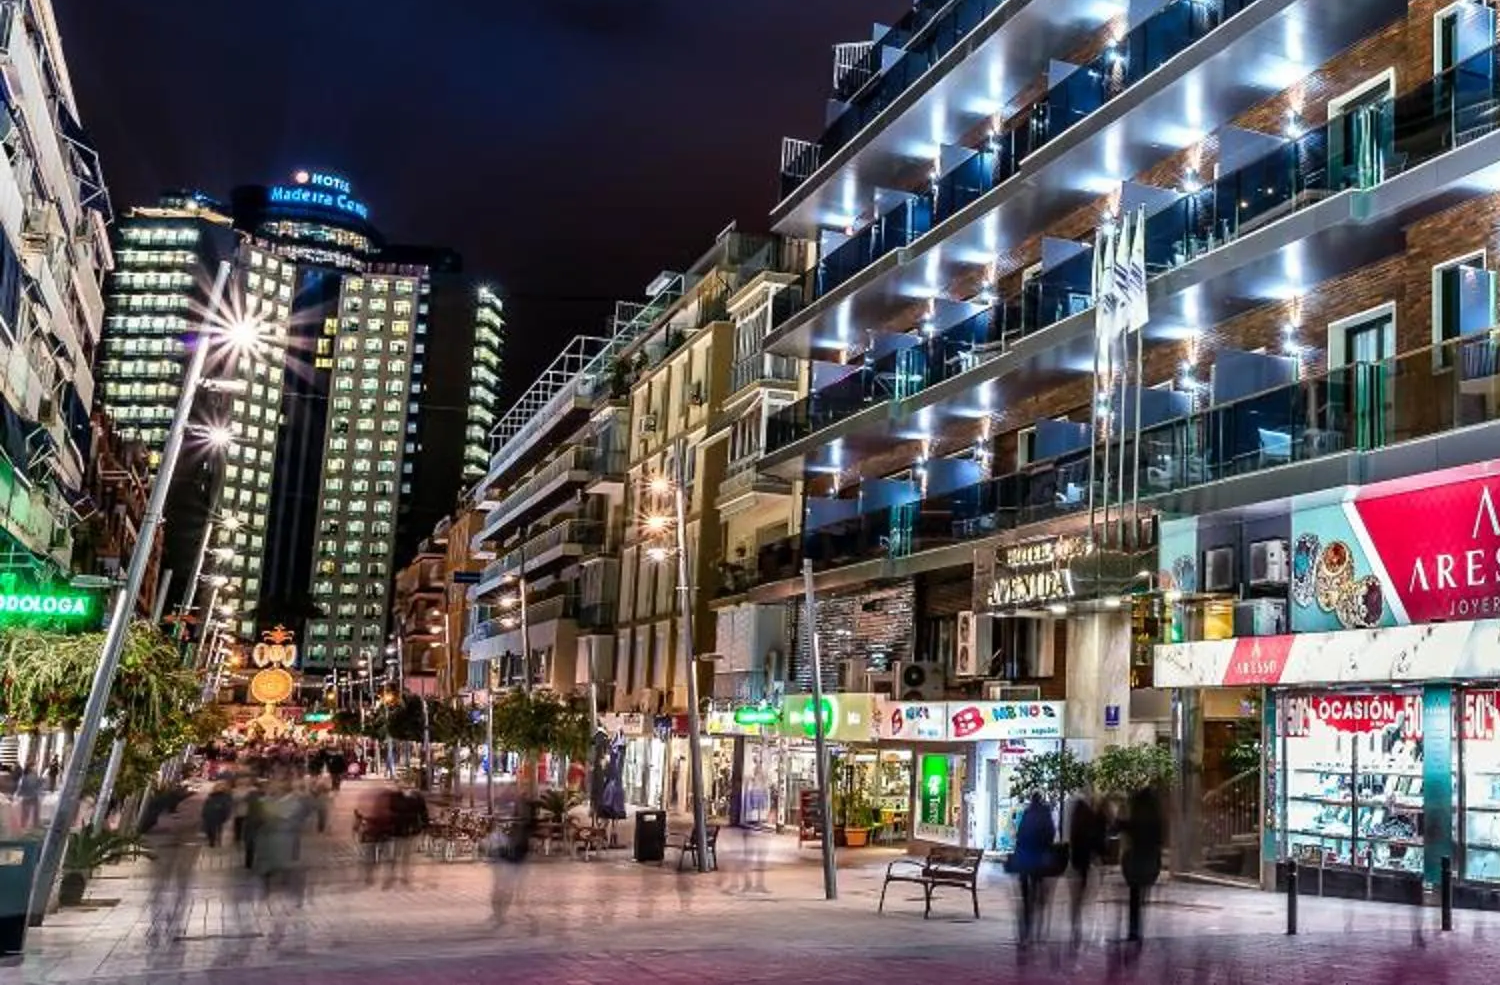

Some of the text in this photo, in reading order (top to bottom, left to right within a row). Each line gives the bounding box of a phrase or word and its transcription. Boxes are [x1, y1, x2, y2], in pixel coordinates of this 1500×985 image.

[271, 186, 333, 206] Madeira
[0, 595, 87, 616] DOLOGA
[1319, 697, 1395, 720] OCASIÓN
